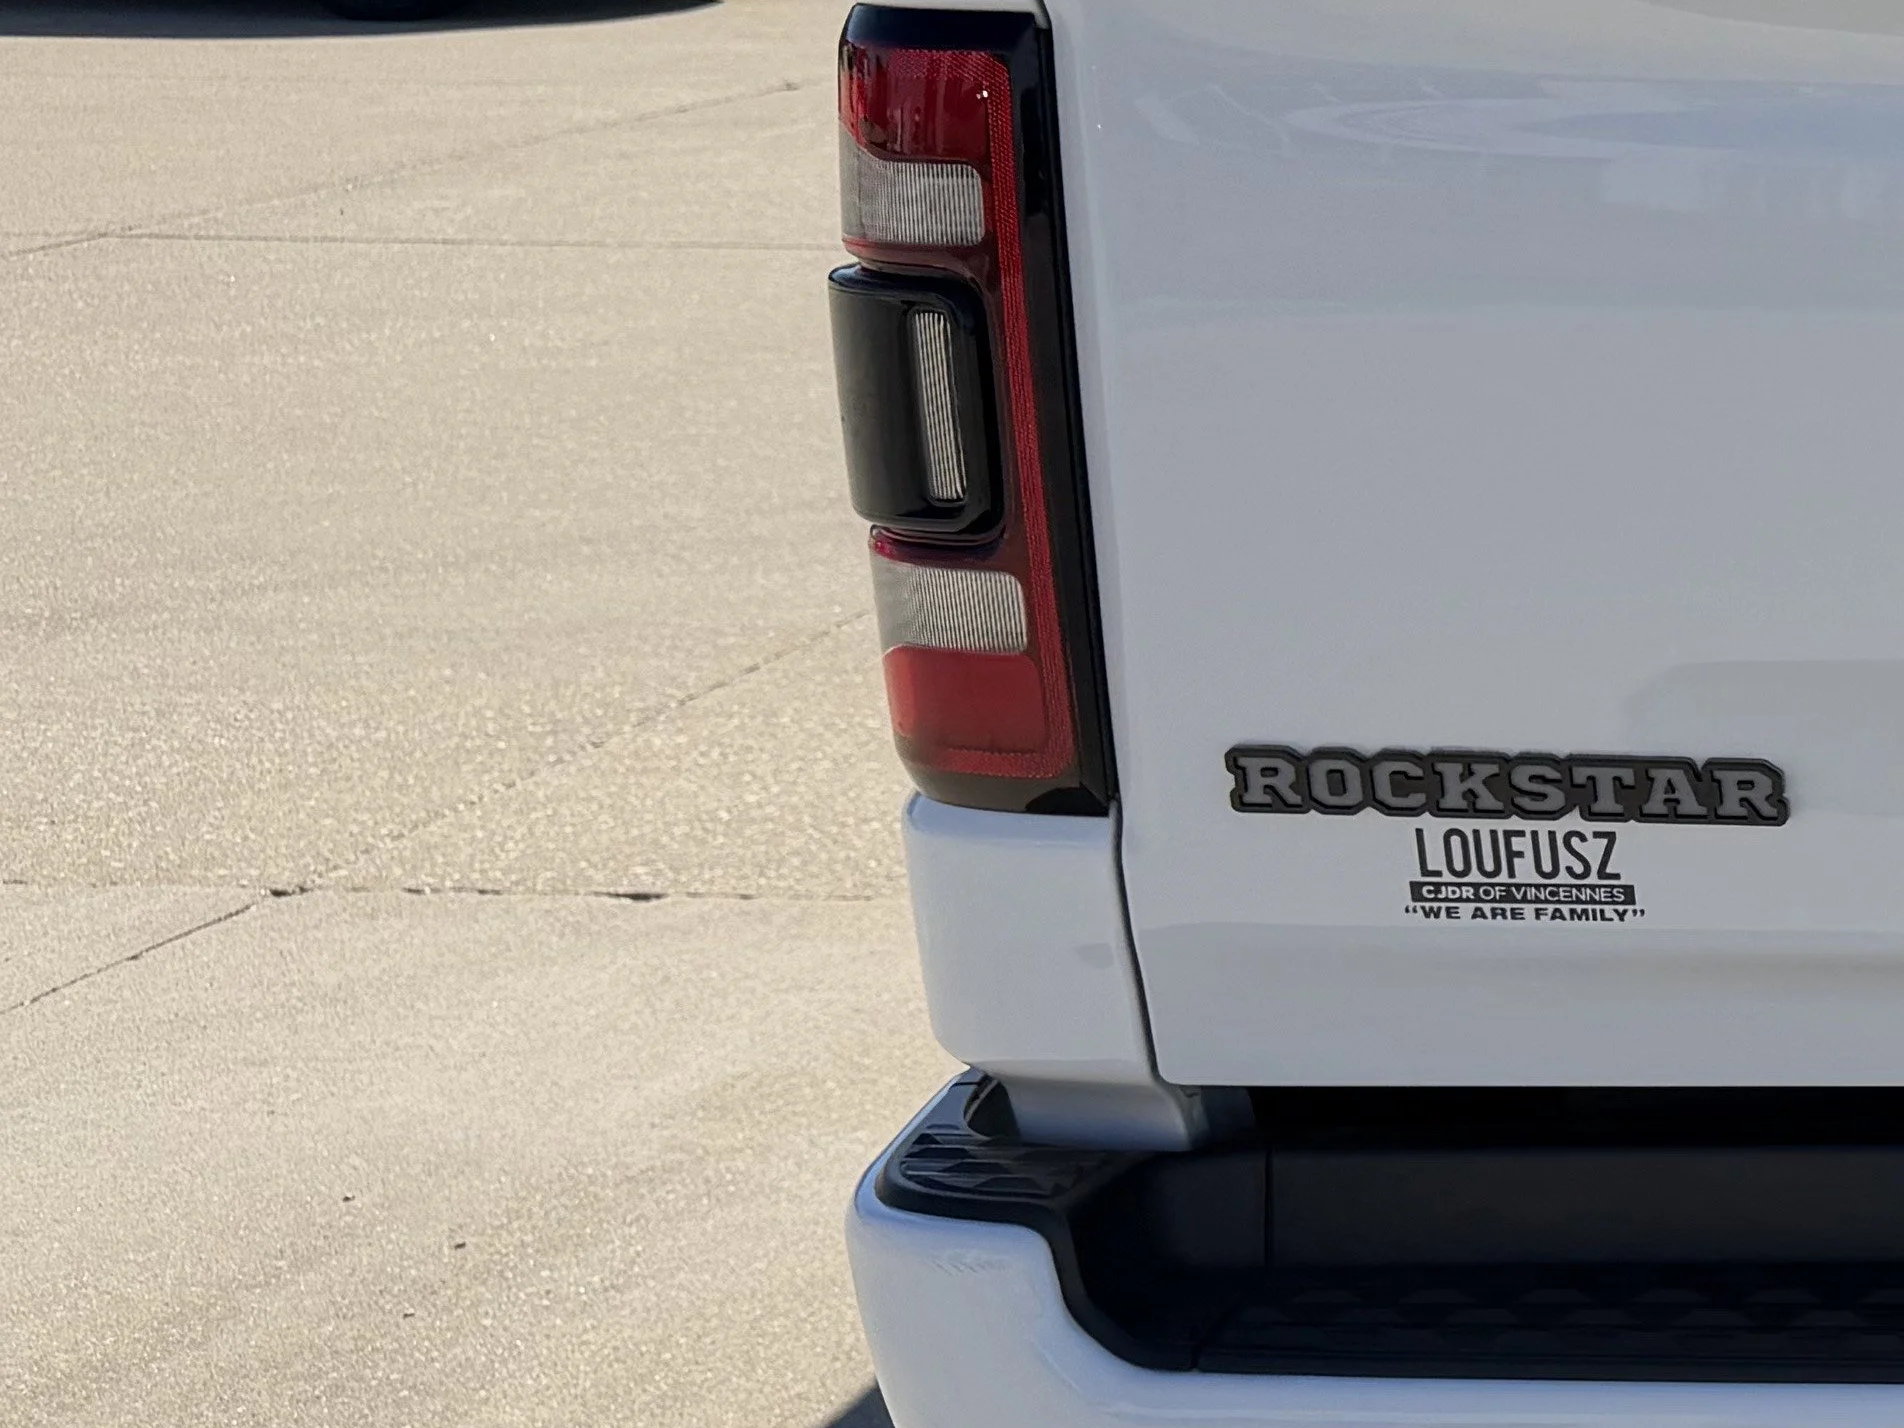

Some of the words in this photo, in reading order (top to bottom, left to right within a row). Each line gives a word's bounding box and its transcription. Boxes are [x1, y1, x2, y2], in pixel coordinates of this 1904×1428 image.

[1224, 744, 1790, 827] ROCKSTAR
[1421, 885, 1475, 900] CJDR
[1478, 886, 1508, 901] OF
[1511, 887, 1626, 903] VINCENNES
[1470, 906, 1526, 921] ARE
